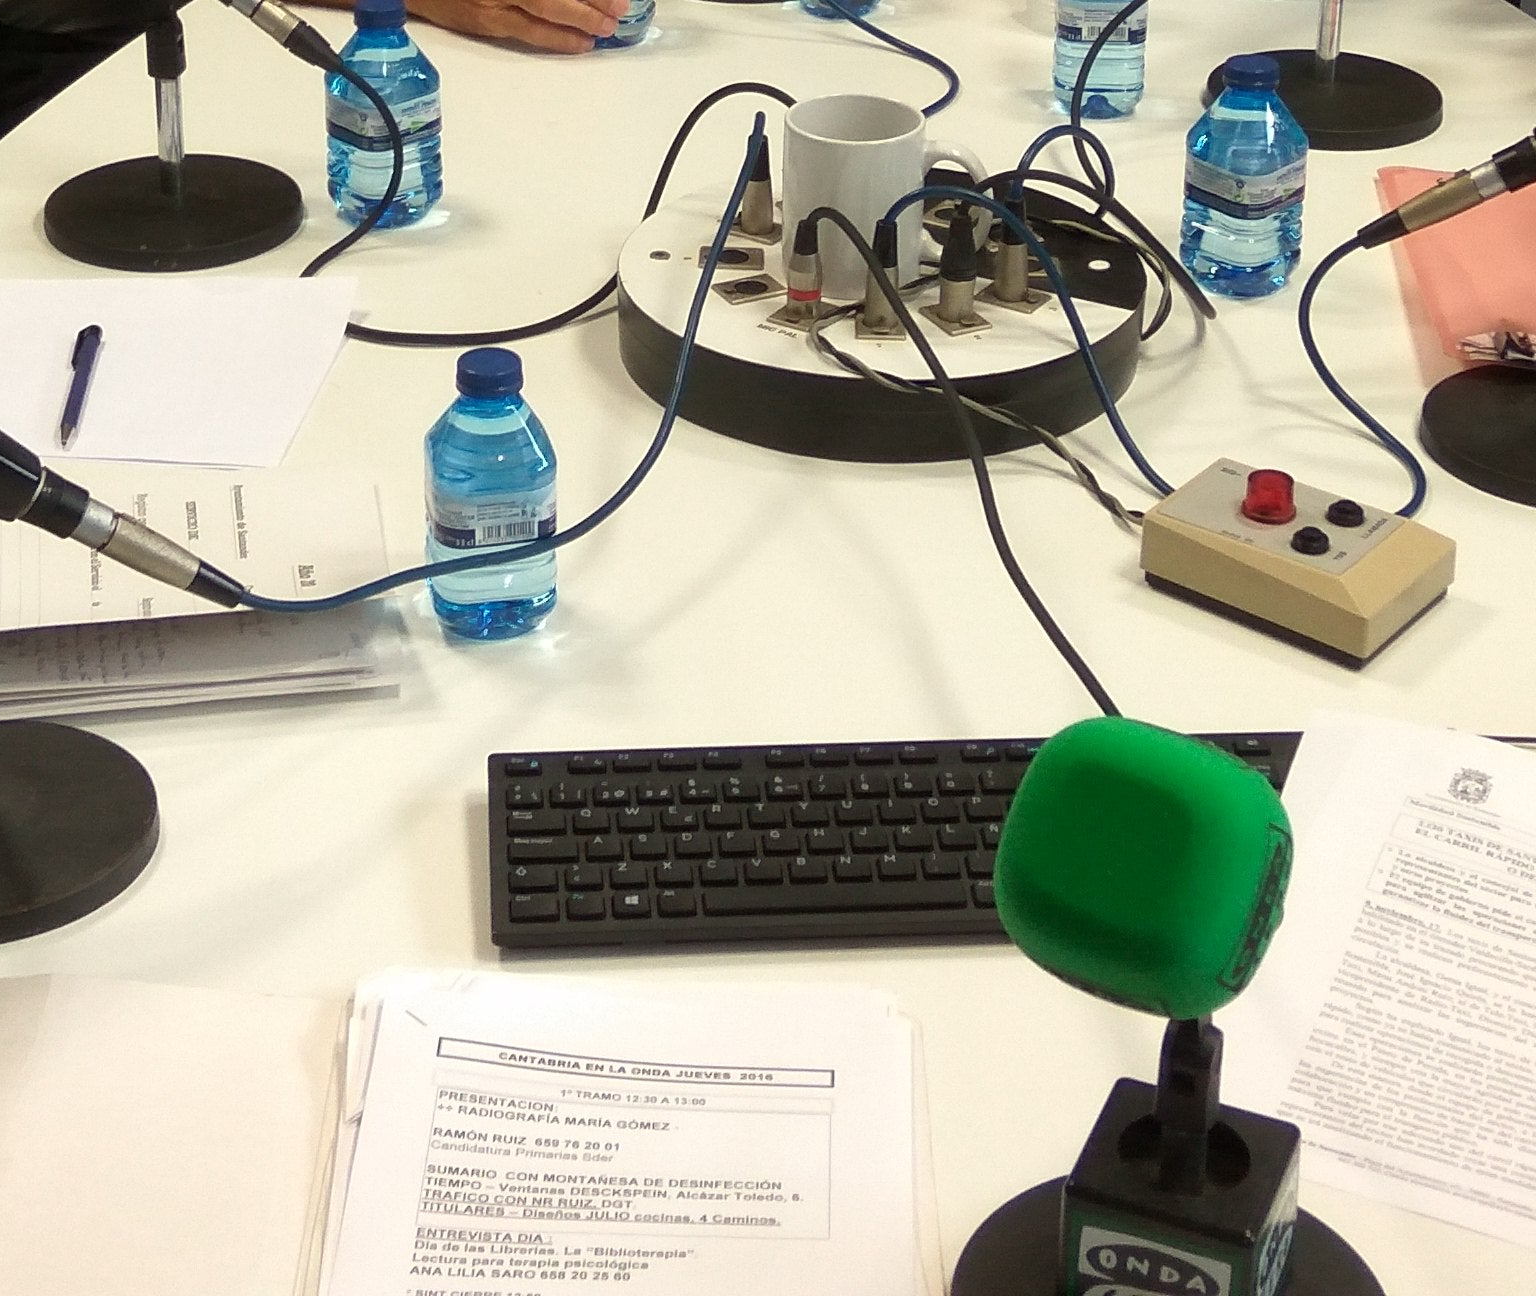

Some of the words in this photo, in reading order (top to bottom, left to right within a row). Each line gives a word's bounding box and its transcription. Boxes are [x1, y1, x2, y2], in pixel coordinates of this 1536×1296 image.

[497, 1051, 581, 1069] CANTABRIA
[584, 1062, 604, 1072] EN
[608, 1064, 626, 1074] LA
[630, 1066, 670, 1077] ONDA
[675, 1069, 731, 1080] JUEVES
[575, 1089, 621, 1101] TRAMO
[625, 1094, 657, 1103] 12:30
[674, 1096, 706, 1106] 13:00
[457, 1104, 559, 1124] RADIOGRAFÍA
[563, 1116, 612, 1128] MARÍA
[615, 1119, 670, 1131] GÓMEZ
[432, 1126, 488, 1142] RAMÓN
[491, 1133, 527, 1145] RUIZ
[430, 1139, 511, 1156] Candidatura
[514, 1147, 578, 1160] Primarias
[426, 1163, 497, 1179] SUMARIO
[504, 1170, 539, 1181] CON
[542, 1173, 638, 1186] MONTAÑESA
[642, 1177, 663, 1187] DE
[668, 1178, 782, 1190] DESINFECCIÓN
[426, 1175, 482, 1190] TIEMPO
[498, 1182, 565, 1195] Ventanas
[493, 1194, 527, 1206] CON
[420, 1200, 504, 1216] TITULARES
[521, 1208, 581, 1220] Diseños
[584, 1210, 630, 1222] JULIO
[415, 1226, 512, 1243] ENTREVISTA
[516, 1232, 543, 1244] DIA
[463, 1242, 485, 1253] las
[563, 1245, 581, 1256] La
[411, 1252, 467, 1264] Lectura
[471, 1257, 504, 1267] para
[508, 1257, 559, 1269] terapia
[409, 1265, 443, 1276] ANA
[447, 1267, 486, 1278] LILIA
[1098, 1247, 1207, 1294] ONDA
